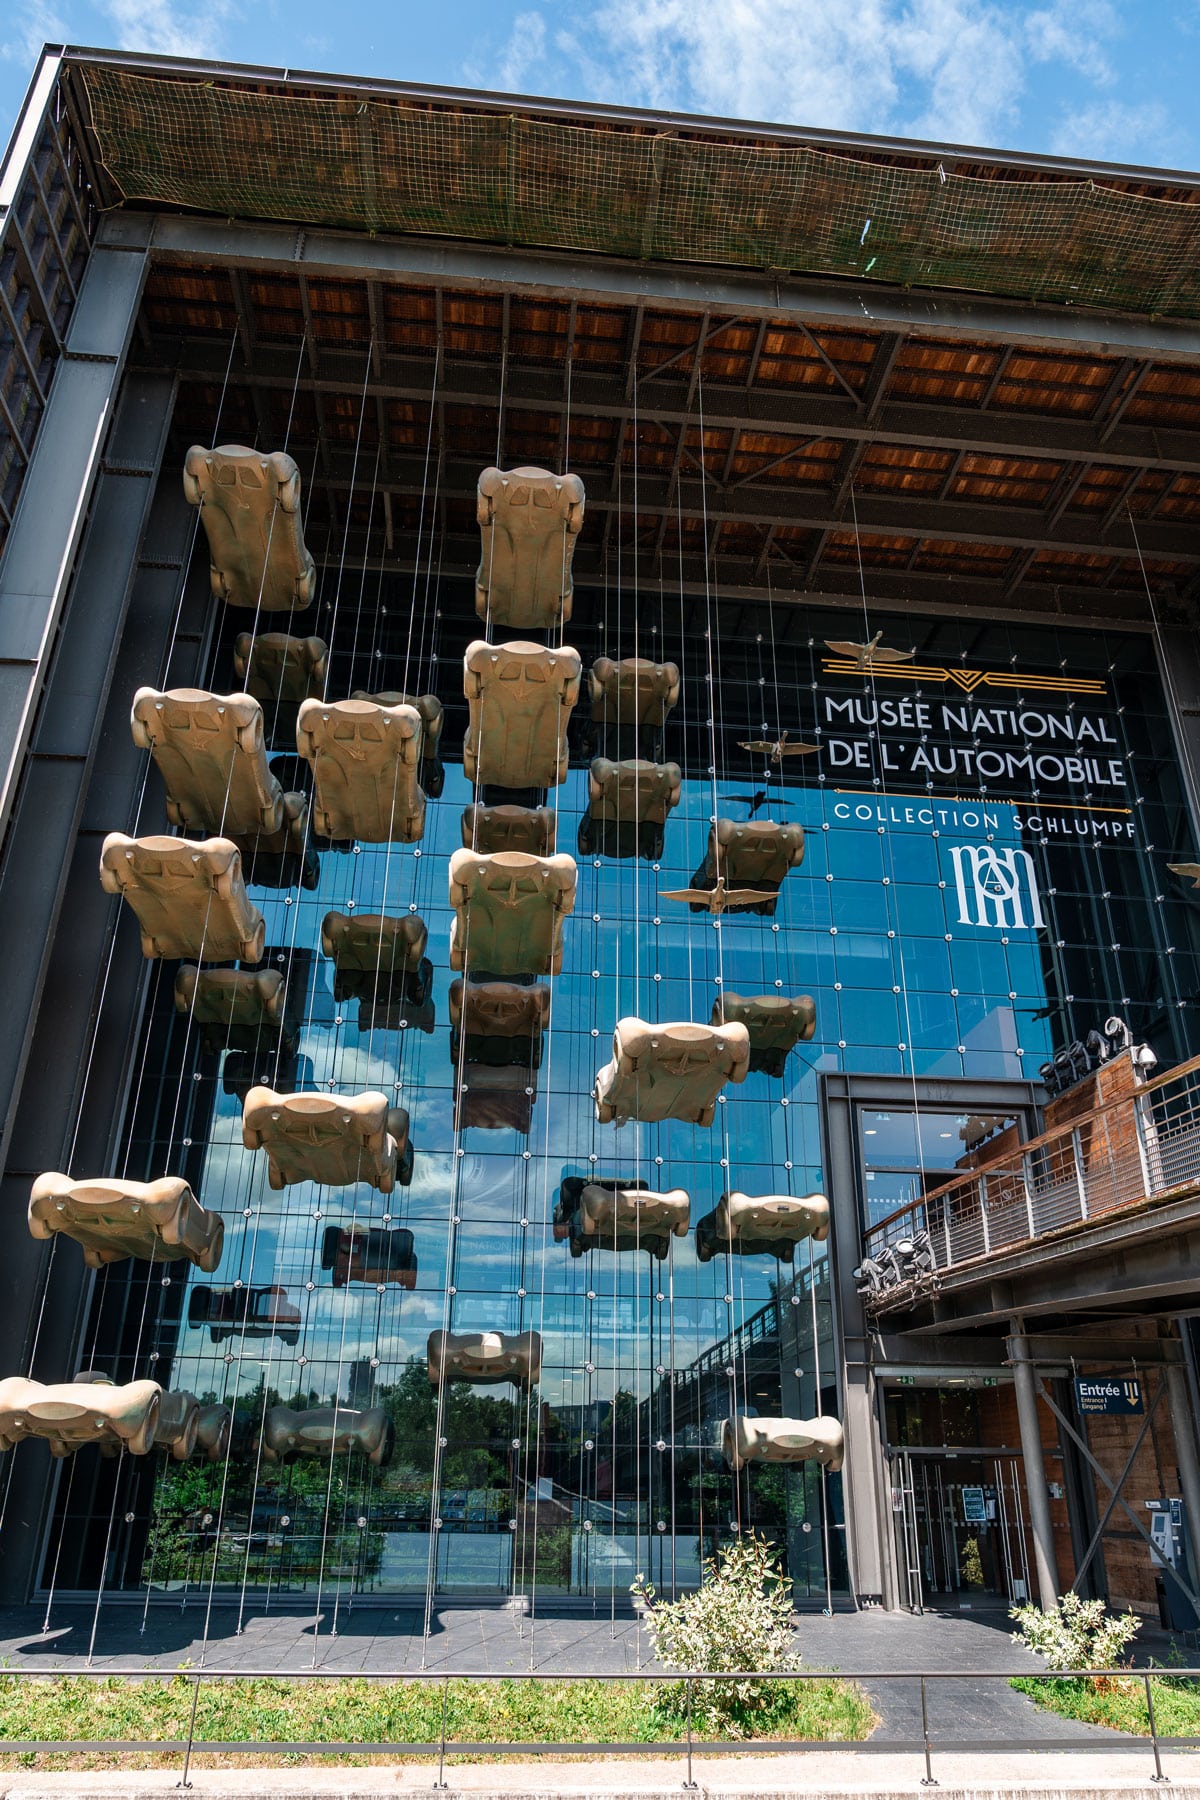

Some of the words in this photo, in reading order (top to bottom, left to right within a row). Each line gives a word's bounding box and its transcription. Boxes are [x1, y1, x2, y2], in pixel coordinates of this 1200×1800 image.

[825, 696, 932, 729] MUSÉE
[942, 705, 1117, 743] NATIONAL
[828, 740, 871, 768] DE
[834, 803, 999, 829] COLLECTION
[1012, 815, 1135, 838] SCHLUMPF
[1079, 1382, 1120, 1396] Entrée
